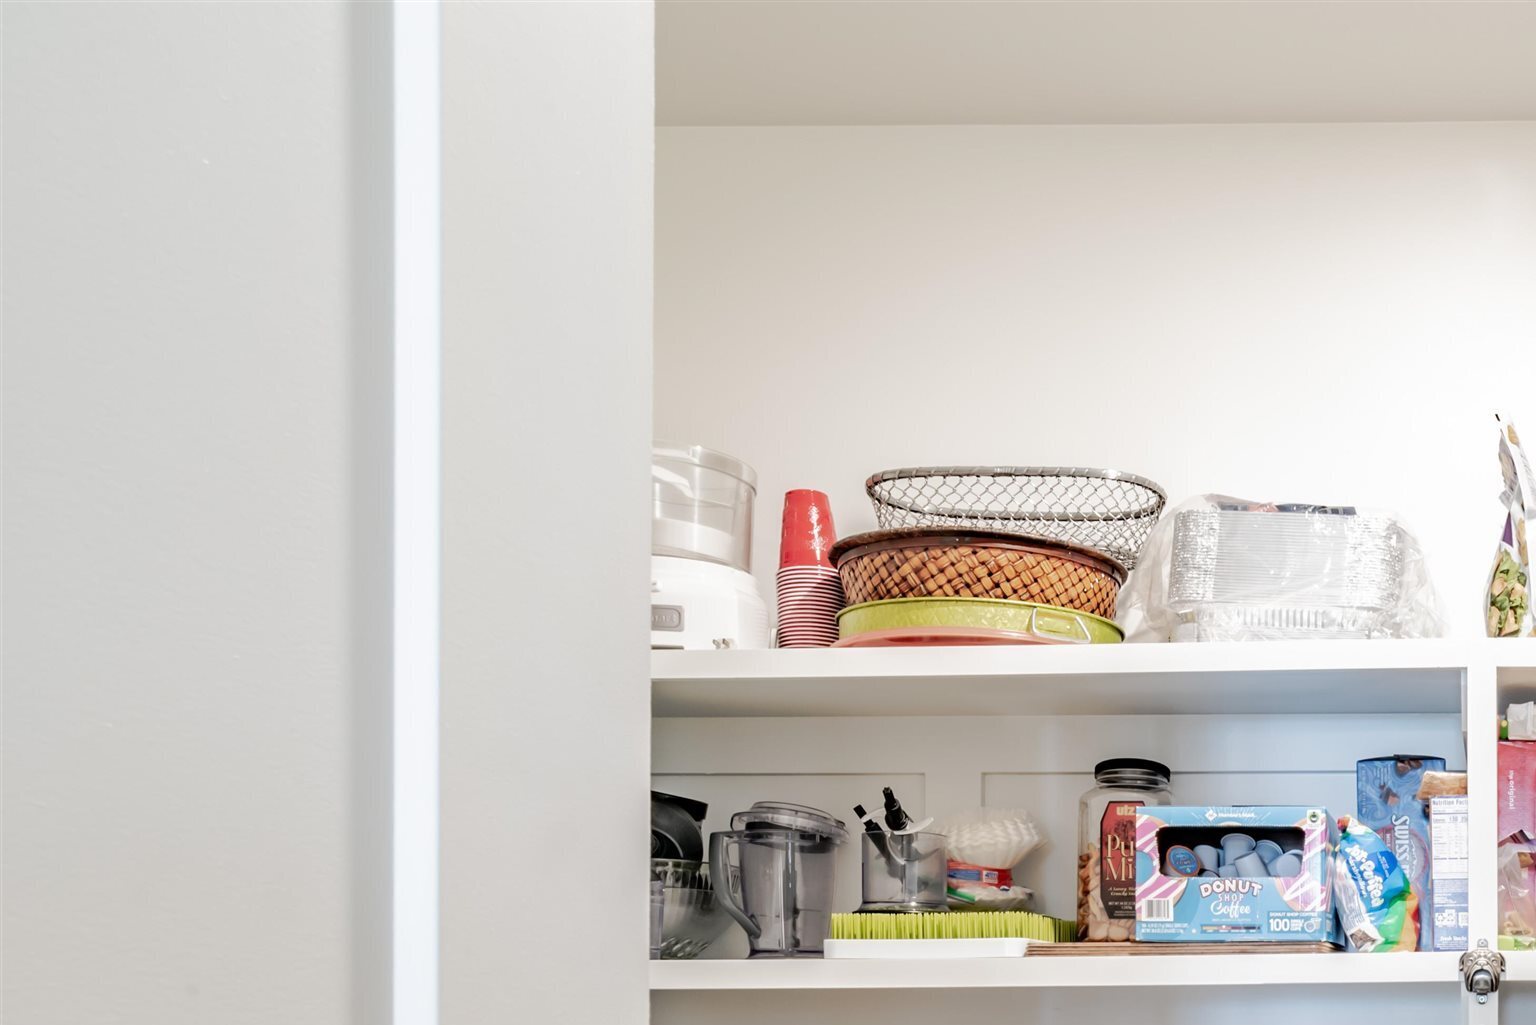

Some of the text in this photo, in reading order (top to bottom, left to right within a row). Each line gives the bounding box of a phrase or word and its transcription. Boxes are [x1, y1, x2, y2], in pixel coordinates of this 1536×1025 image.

[1508, 781, 1516, 810] original
[1116, 805, 1135, 815] utz
[1106, 834, 1134, 858] Pu
[1392, 815, 1410, 861] SWISS
[1106, 857, 1133, 880] Mi
[1199, 879, 1263, 898] DONUT
[1210, 900, 1251, 918] Coffee
[1269, 920, 1290, 931] 100
